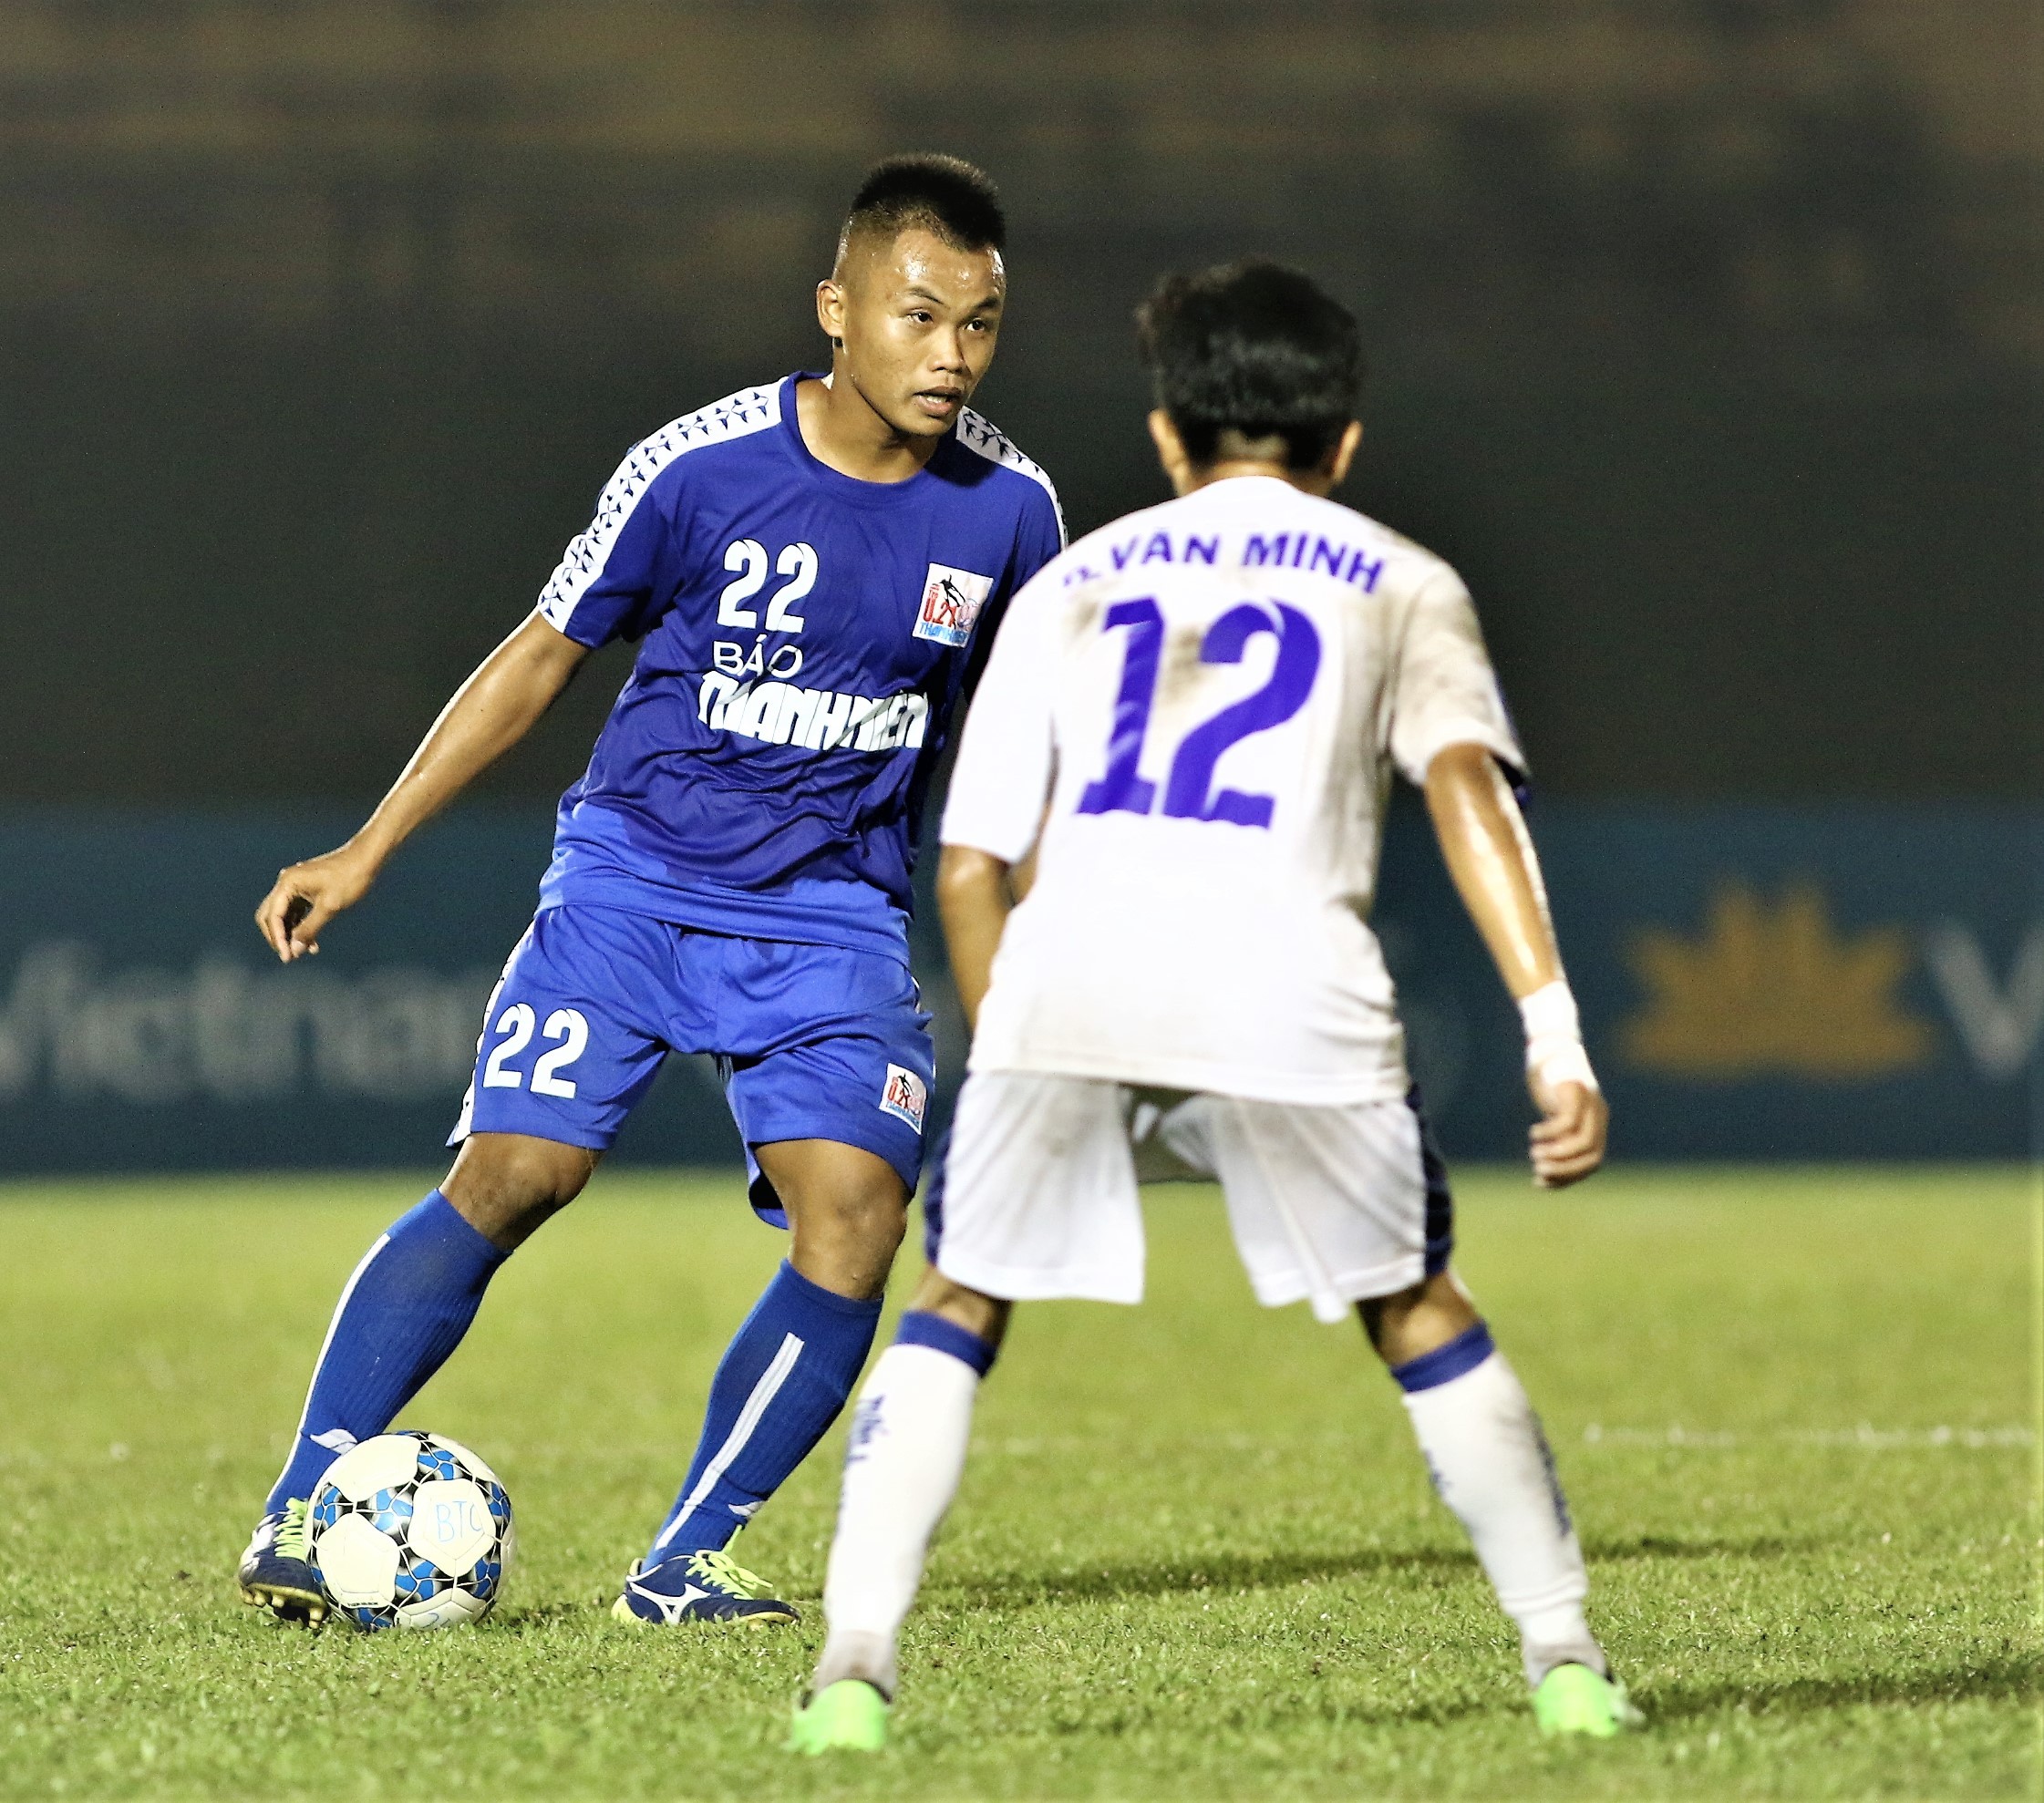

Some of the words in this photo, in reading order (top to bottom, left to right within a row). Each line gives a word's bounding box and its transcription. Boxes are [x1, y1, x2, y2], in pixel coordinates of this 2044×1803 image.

[716, 538, 819, 634] 22
[1243, 532, 1385, 593] MINH
[1076, 594, 1322, 830] 12
[482, 1003, 589, 1098] 22
